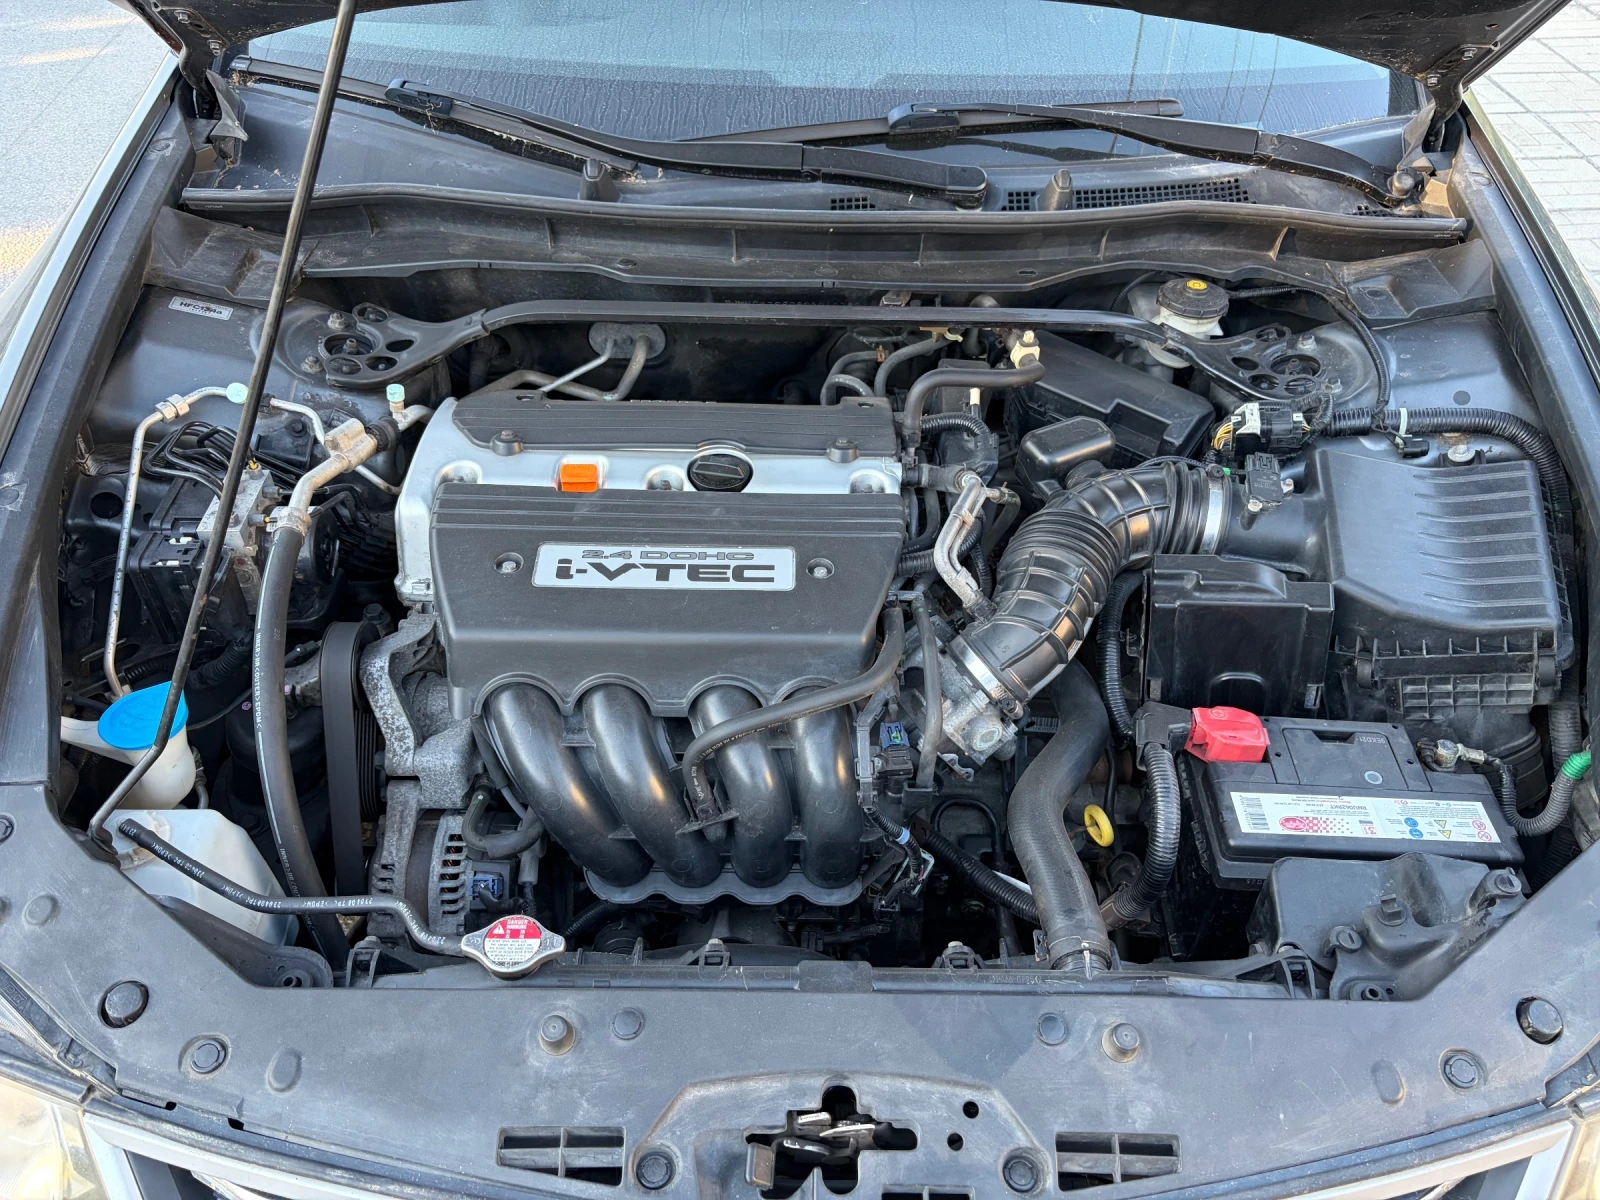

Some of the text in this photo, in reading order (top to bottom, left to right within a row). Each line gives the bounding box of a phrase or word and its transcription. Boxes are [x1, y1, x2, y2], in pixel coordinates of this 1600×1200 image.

[582, 549, 755, 561] 2.4 DOHC
[555, 558, 775, 583] i-VTEC
